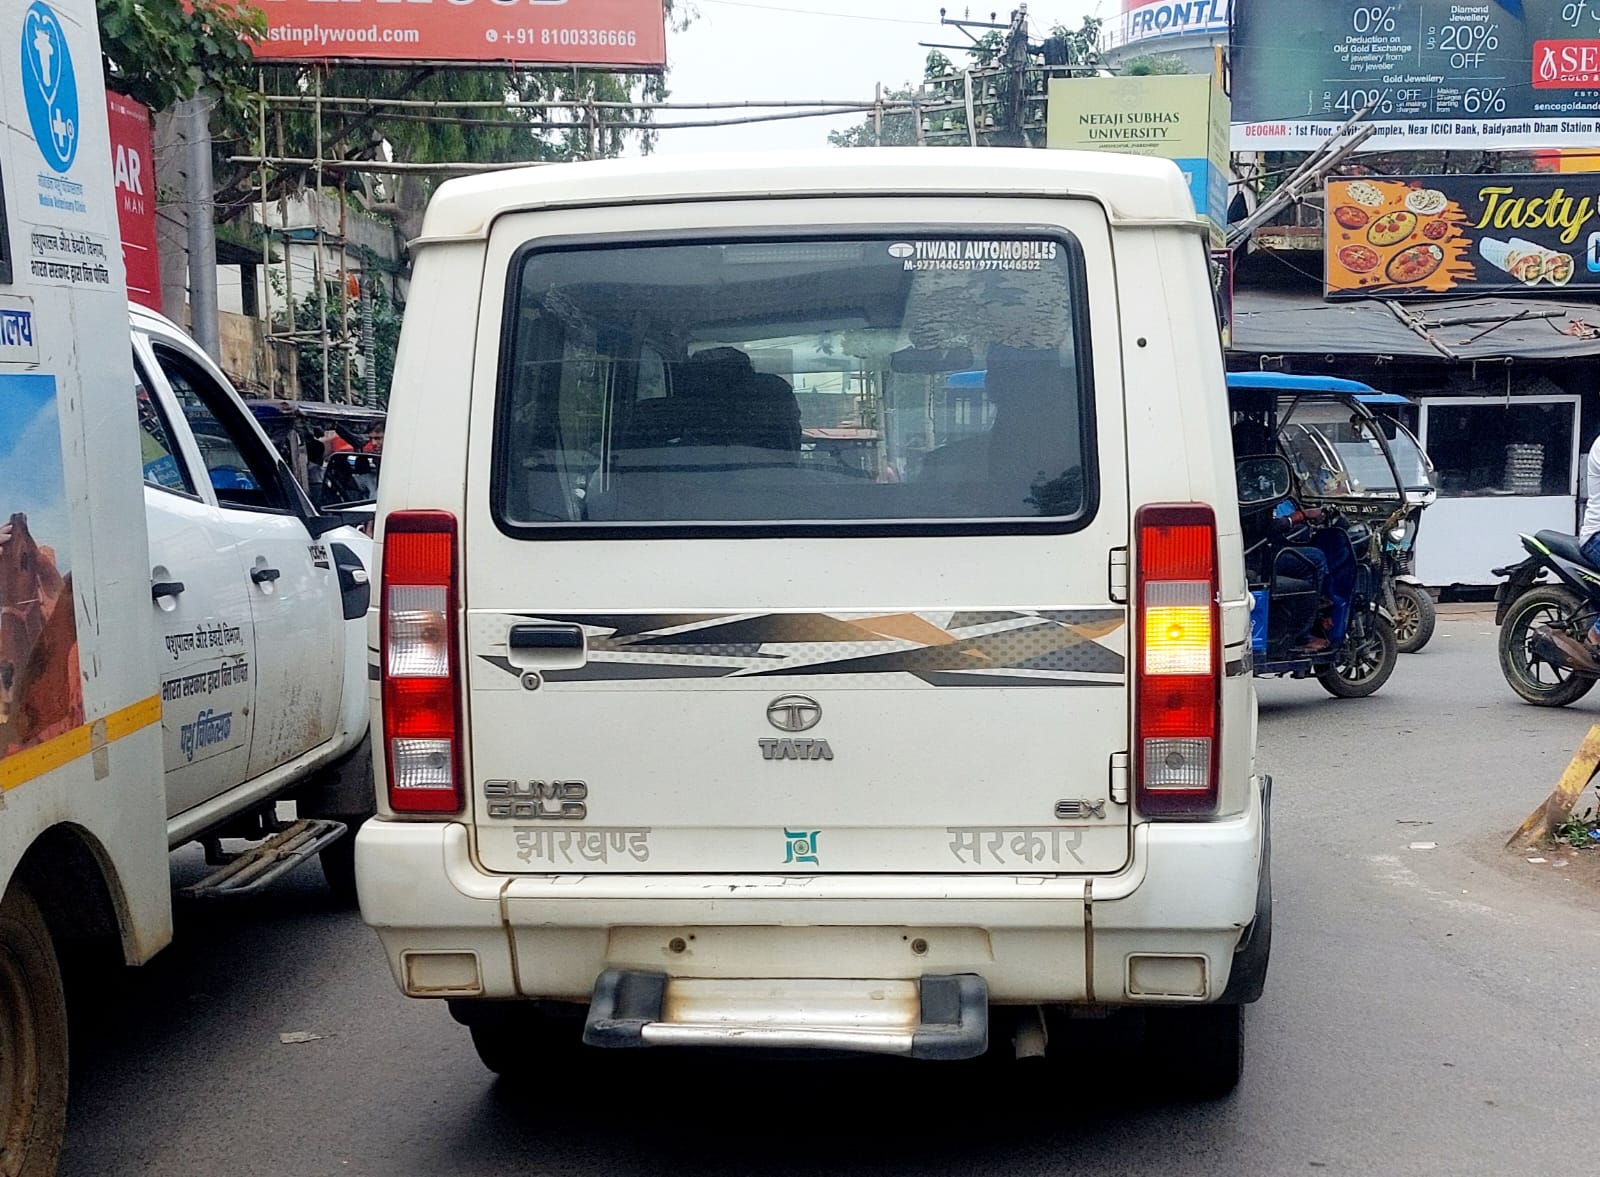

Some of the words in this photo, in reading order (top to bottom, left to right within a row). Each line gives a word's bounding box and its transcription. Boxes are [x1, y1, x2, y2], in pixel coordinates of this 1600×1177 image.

[1449, 14, 1490, 23] Jewellery
[1451, 5, 1489, 13] Diamond
[266, 24, 420, 46] stinplywood.com
[502, 28, 534, 44] +91
[541, 28, 637, 47] 8100336666
[1345, 36, 1388, 44] Deduction
[1333, 45, 1349, 53] Old
[1350, 44, 1370, 53] Gold
[1371, 44, 1412, 53] Exchange
[1341, 53, 1350, 61] of
[1351, 53, 1384, 63] jewellery
[1385, 52, 1404, 60] from
[1349, 62, 1364, 72] any
[1364, 62, 1395, 72] jeweller
[1450, 53, 1487, 69] OFF
[1382, 75, 1403, 83] Gold
[1404, 74, 1445, 84] Jewellery
[1396, 89, 1422, 101] OFF
[1079, 113, 1123, 126] NETAJI
[1127, 112, 1180, 124] SUBHAS
[1088, 127, 1169, 140] UNIVERSITY
[1245, 124, 1286, 137] DEOGHAR
[1294, 125, 1308, 136] 1st
[1408, 123, 1428, 135] Near
[1431, 123, 1452, 134] ICICI
[1455, 123, 1480, 136] Bank,
[1482, 122, 1531, 136] Baidyanath
[1534, 121, 1558, 133] Dham
[1561, 121, 1592, 133] Station
[124, 196, 145, 216] MAN
[1474, 186, 1595, 244] Tasty
[915, 241, 961, 260] TIWARI
[964, 241, 1057, 260] AUTOMOBILES
[165, 632, 195, 661] पशुपालन
[195, 623, 209, 649] और
[162, 678, 181, 701] भारत
[182, 672, 207, 697] सरकार
[180, 721, 196, 762] पशु
[758, 737, 835, 761] TATA
[483, 778, 589, 801] SUMO
[486, 800, 588, 820] GOLD
[1053, 798, 1106, 820] EX
[512, 825, 652, 865] झारखण्ड
[946, 825, 1090, 865] सरकार
